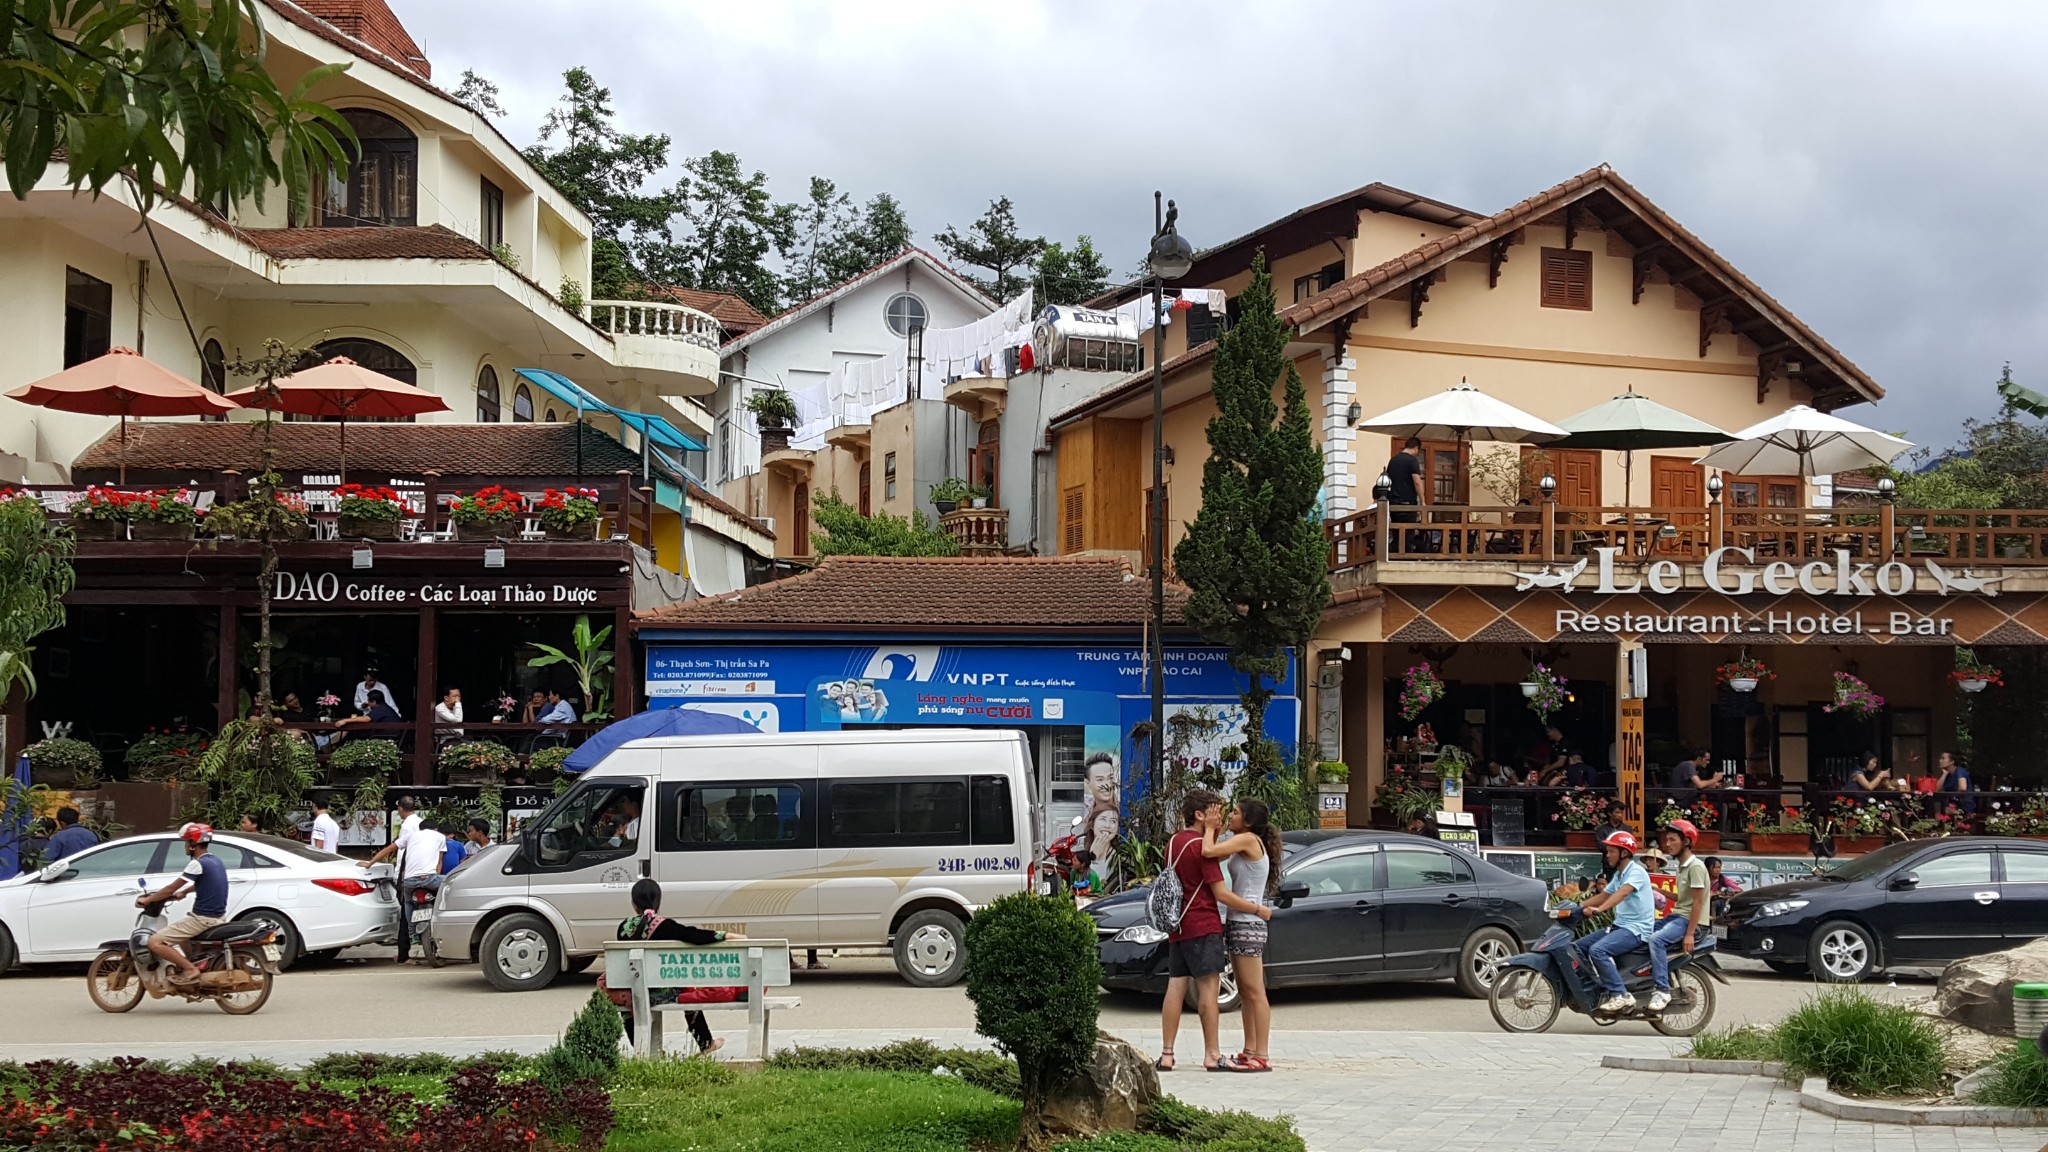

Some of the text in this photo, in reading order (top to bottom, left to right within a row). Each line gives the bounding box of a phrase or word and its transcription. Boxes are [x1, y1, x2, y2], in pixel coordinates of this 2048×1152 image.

[1593, 546, 1915, 597] Le Gecko
[274, 572, 340, 602] DAO
[345, 584, 406, 602] Coffee
[420, 583, 453, 602] Các
[459, 585, 496, 605] Loại
[502, 582, 546, 602] Thảo
[553, 585, 597, 605] Dược
[1555, 610, 1742, 634] Restaurant
[1768, 611, 1862, 635] Hotel
[1889, 612, 1953, 636] Bar
[1077, 652, 1120, 661] TRUNG
[747, 659, 758, 668] Sa
[760, 659, 770, 668] Pa
[1118, 667, 1150, 675] VNPT
[1182, 667, 1202, 675] CAI
[947, 673, 1009, 686] VNPT
[655, 685, 684, 694] vinaphone
[952, 693, 983, 704] nghe
[941, 706, 964, 715] sóng
[966, 706, 984, 717] nụ
[986, 704, 1032, 719] cười
[516, 795, 538, 806] Đồ
[1326, 797, 1340, 805] 04
[1459, 832, 1475, 841] SAPA
[937, 856, 1020, 872] 24B-002.80
[1776, 862, 1804, 871] Bakery
[701, 923, 747, 935] TRANSIT
[658, 953, 740, 965] TAXI XANH
[660, 966, 741, 979] 0203 63 63 63
